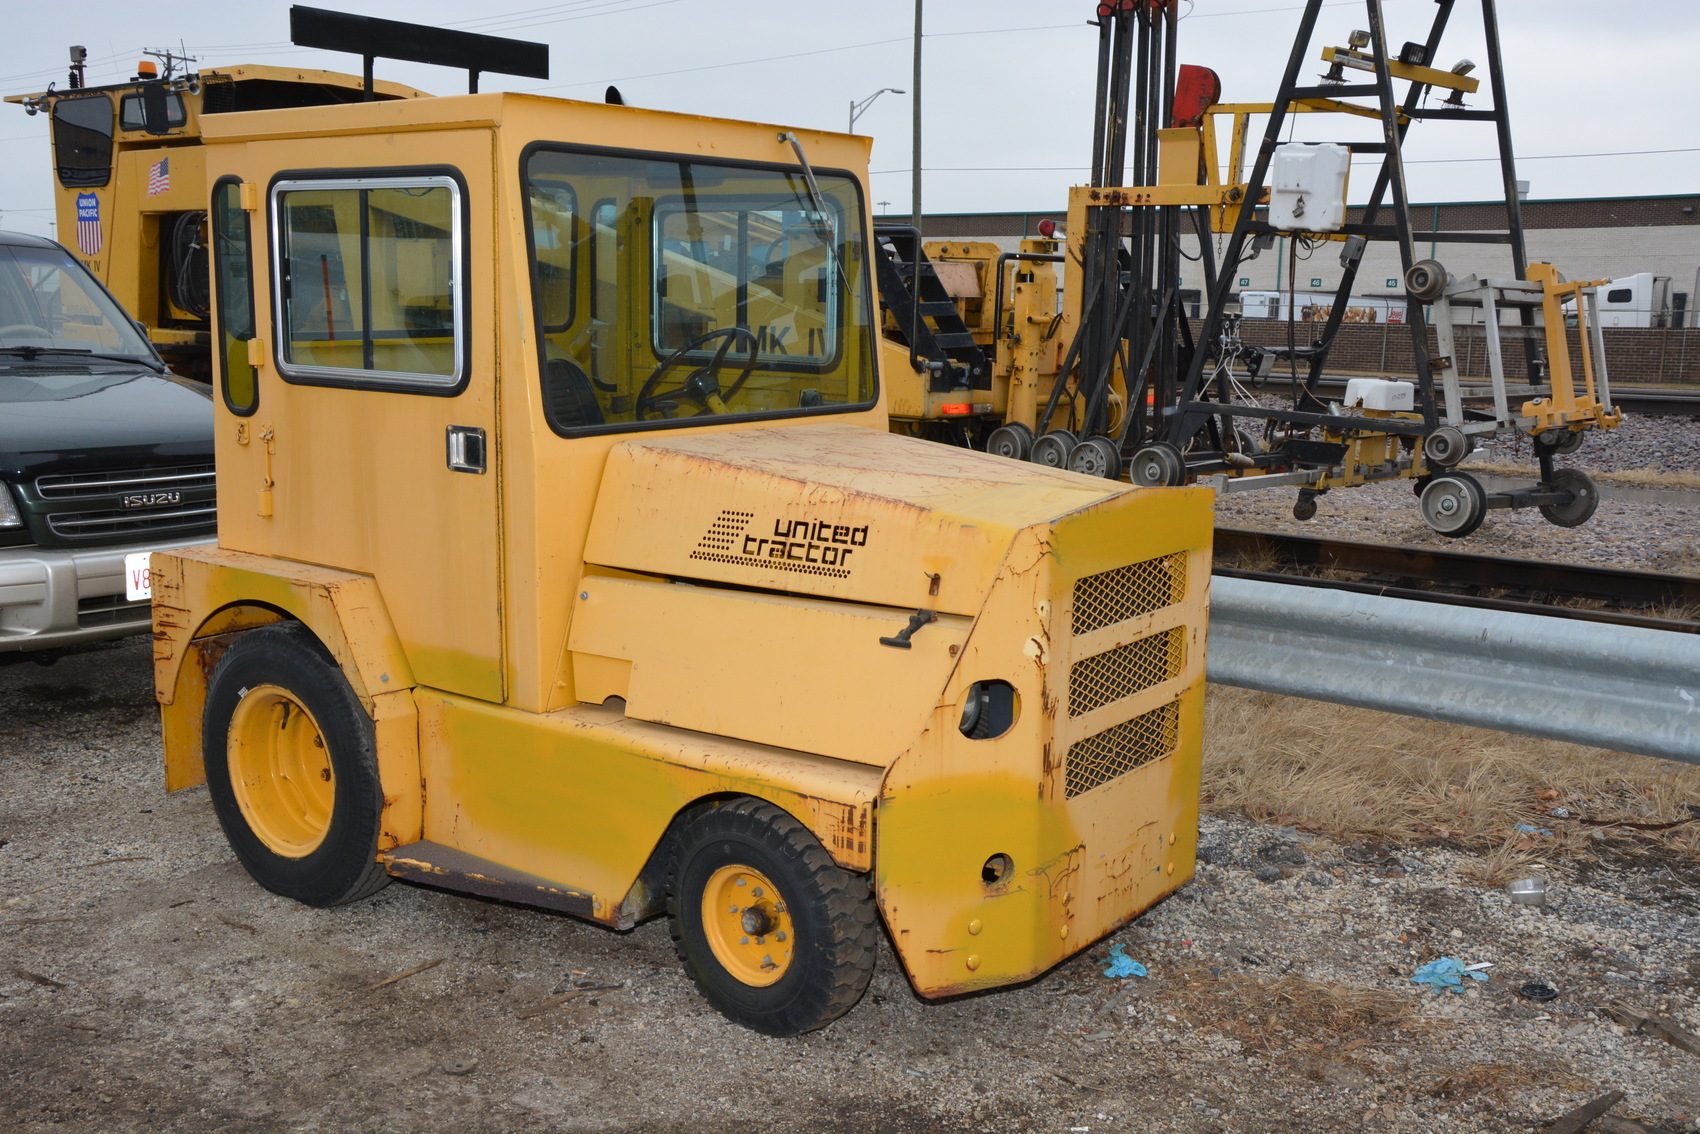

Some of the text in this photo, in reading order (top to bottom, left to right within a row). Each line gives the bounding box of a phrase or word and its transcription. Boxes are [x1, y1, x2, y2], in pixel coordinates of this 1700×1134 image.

[79, 198, 96, 207] UNION
[79, 208, 98, 217] PACIFIC
[1311, 279, 1320, 287] 46
[124, 492, 180, 508] ISUZU
[774, 518, 869, 547] united
[742, 534, 853, 567] tractor
